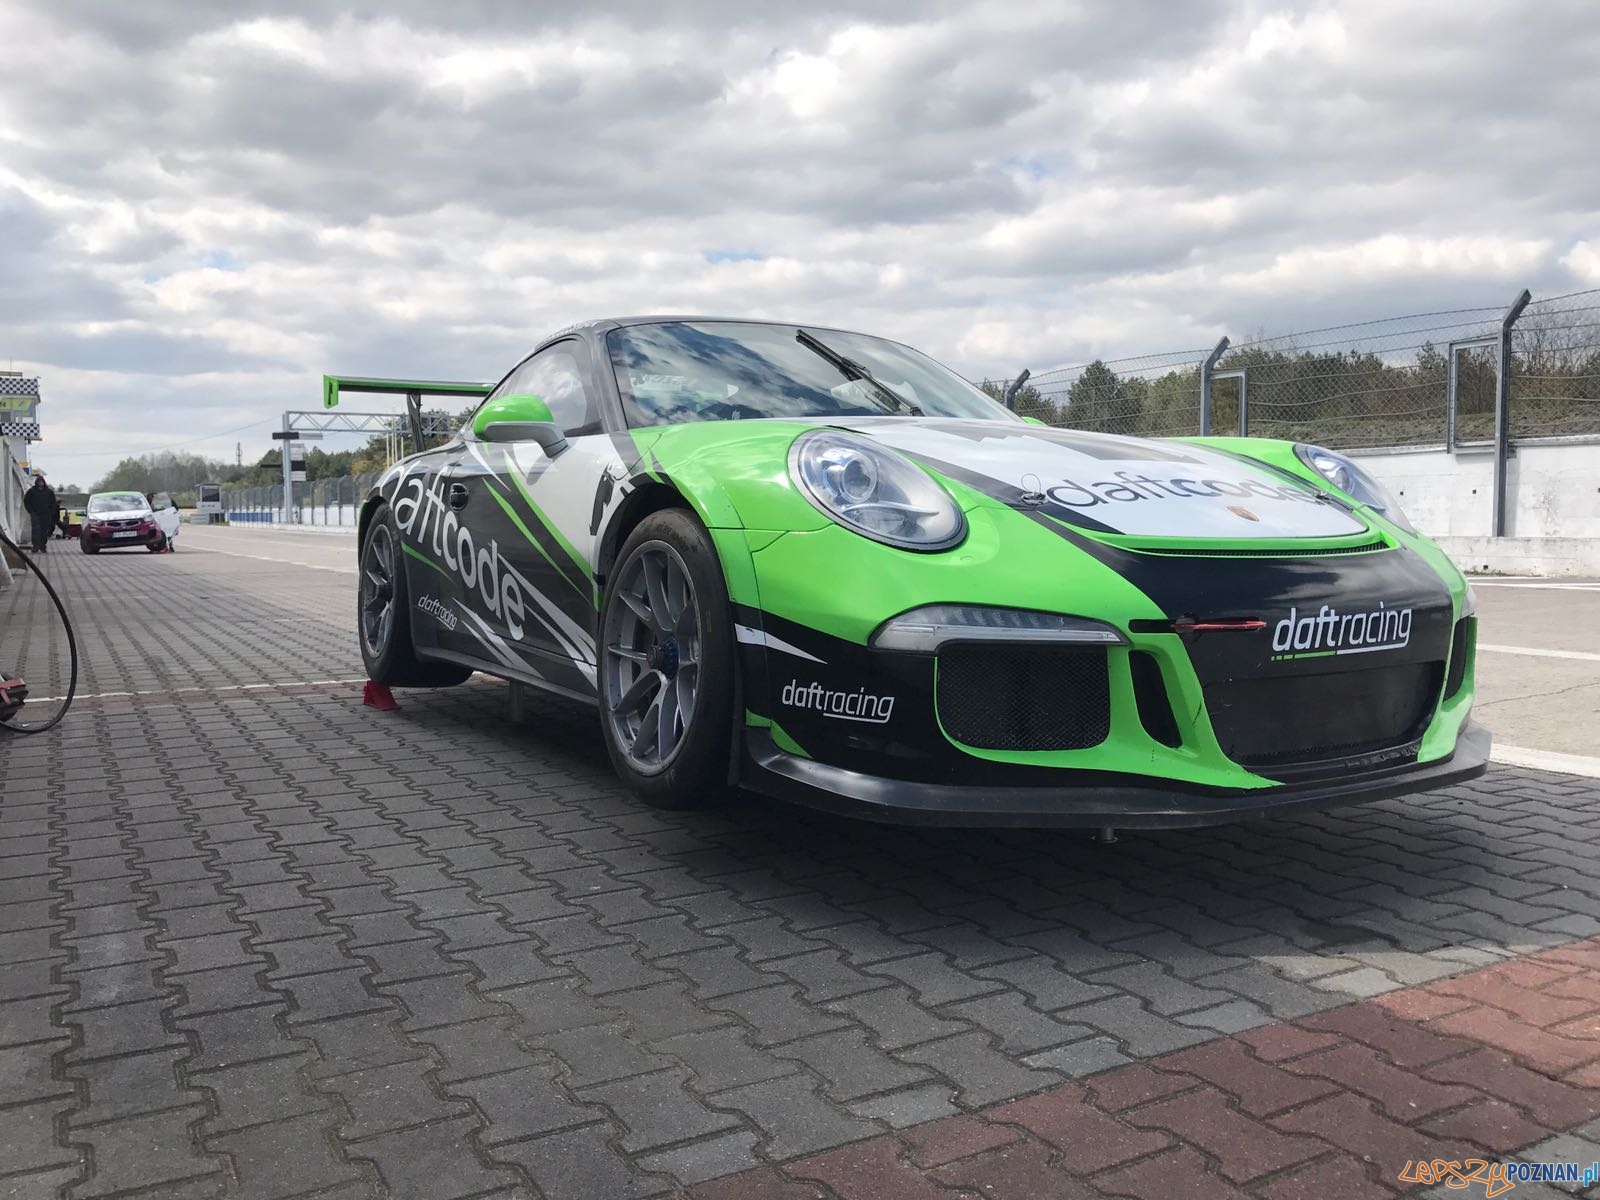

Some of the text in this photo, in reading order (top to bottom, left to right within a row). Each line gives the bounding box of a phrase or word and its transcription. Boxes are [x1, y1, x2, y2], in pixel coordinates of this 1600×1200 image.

[1046, 472, 1321, 508] daftcode
[417, 594, 457, 631] daftracing
[1272, 601, 1412, 654] daftracing
[782, 679, 894, 723] daftracing
